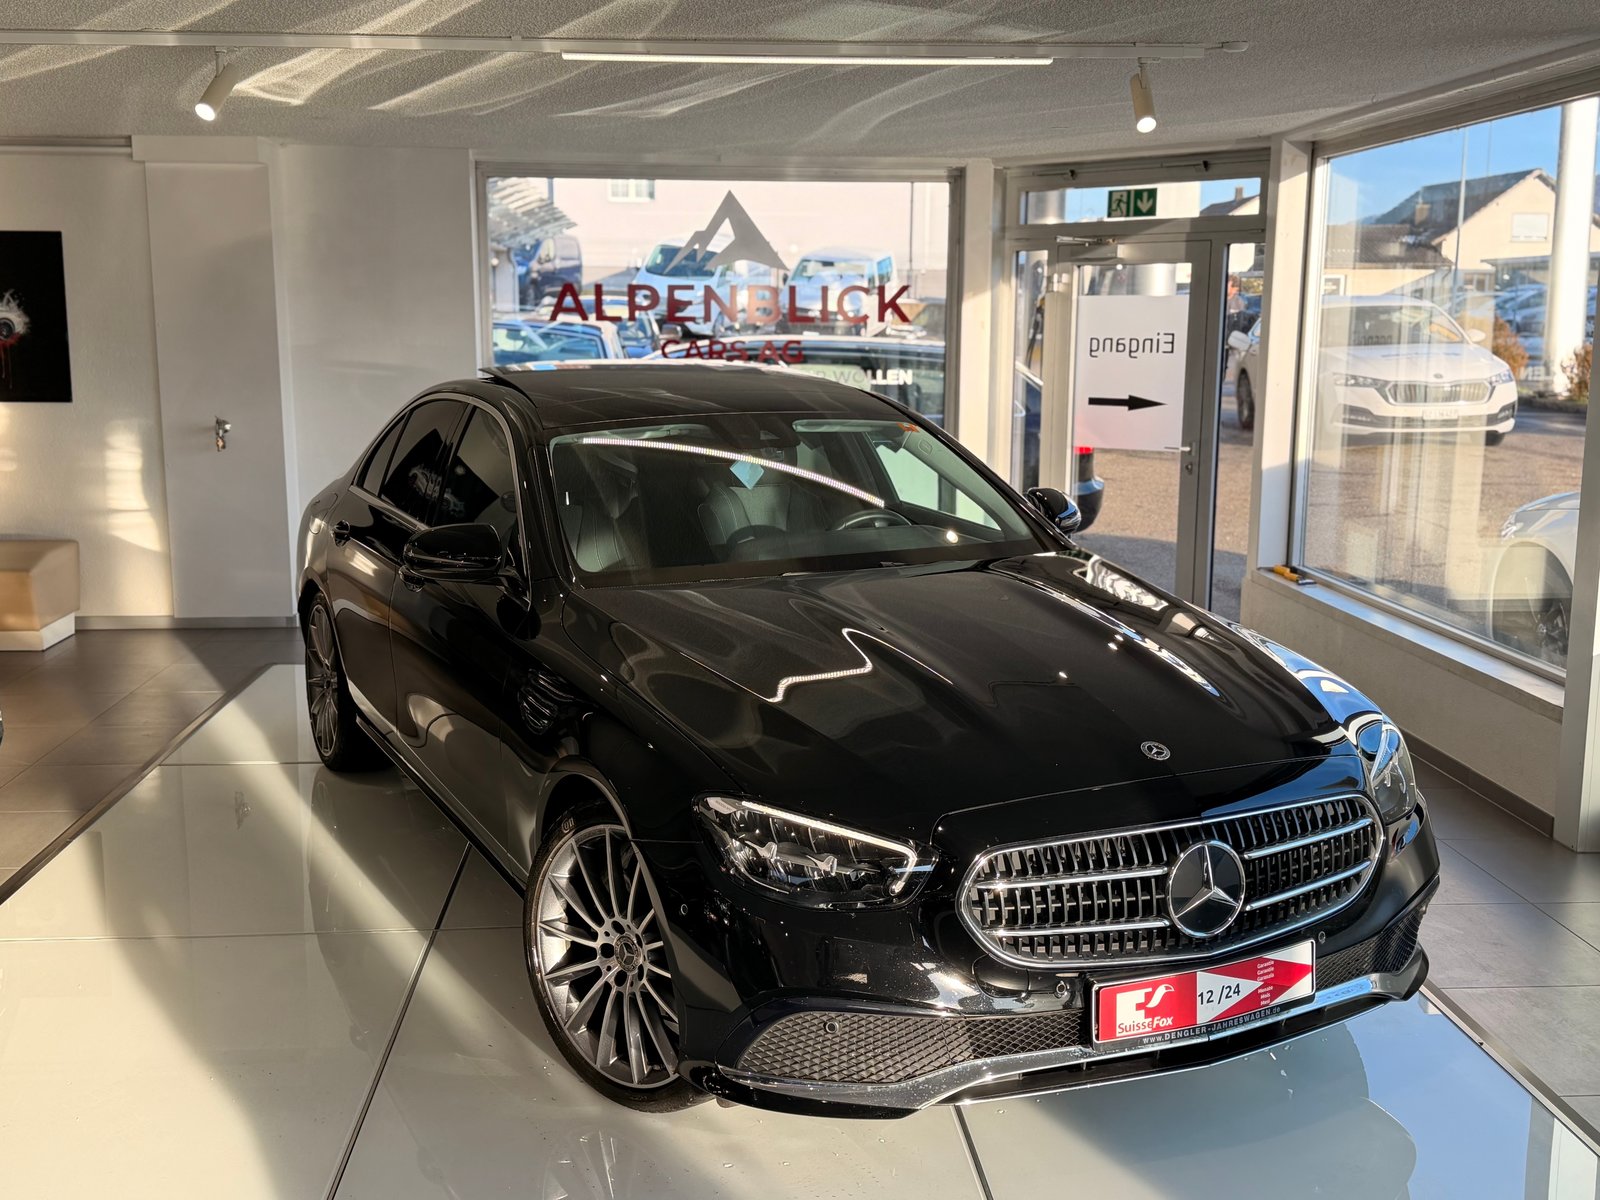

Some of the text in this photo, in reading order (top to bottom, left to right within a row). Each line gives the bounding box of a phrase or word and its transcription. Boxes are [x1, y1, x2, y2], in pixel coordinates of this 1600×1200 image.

[549, 282, 911, 323] ALPENBLICK
[661, 338, 804, 365] CARS AG
[1142, 1007, 1281, 1044] www.DENGLER-JAHRESWAGEN.de
